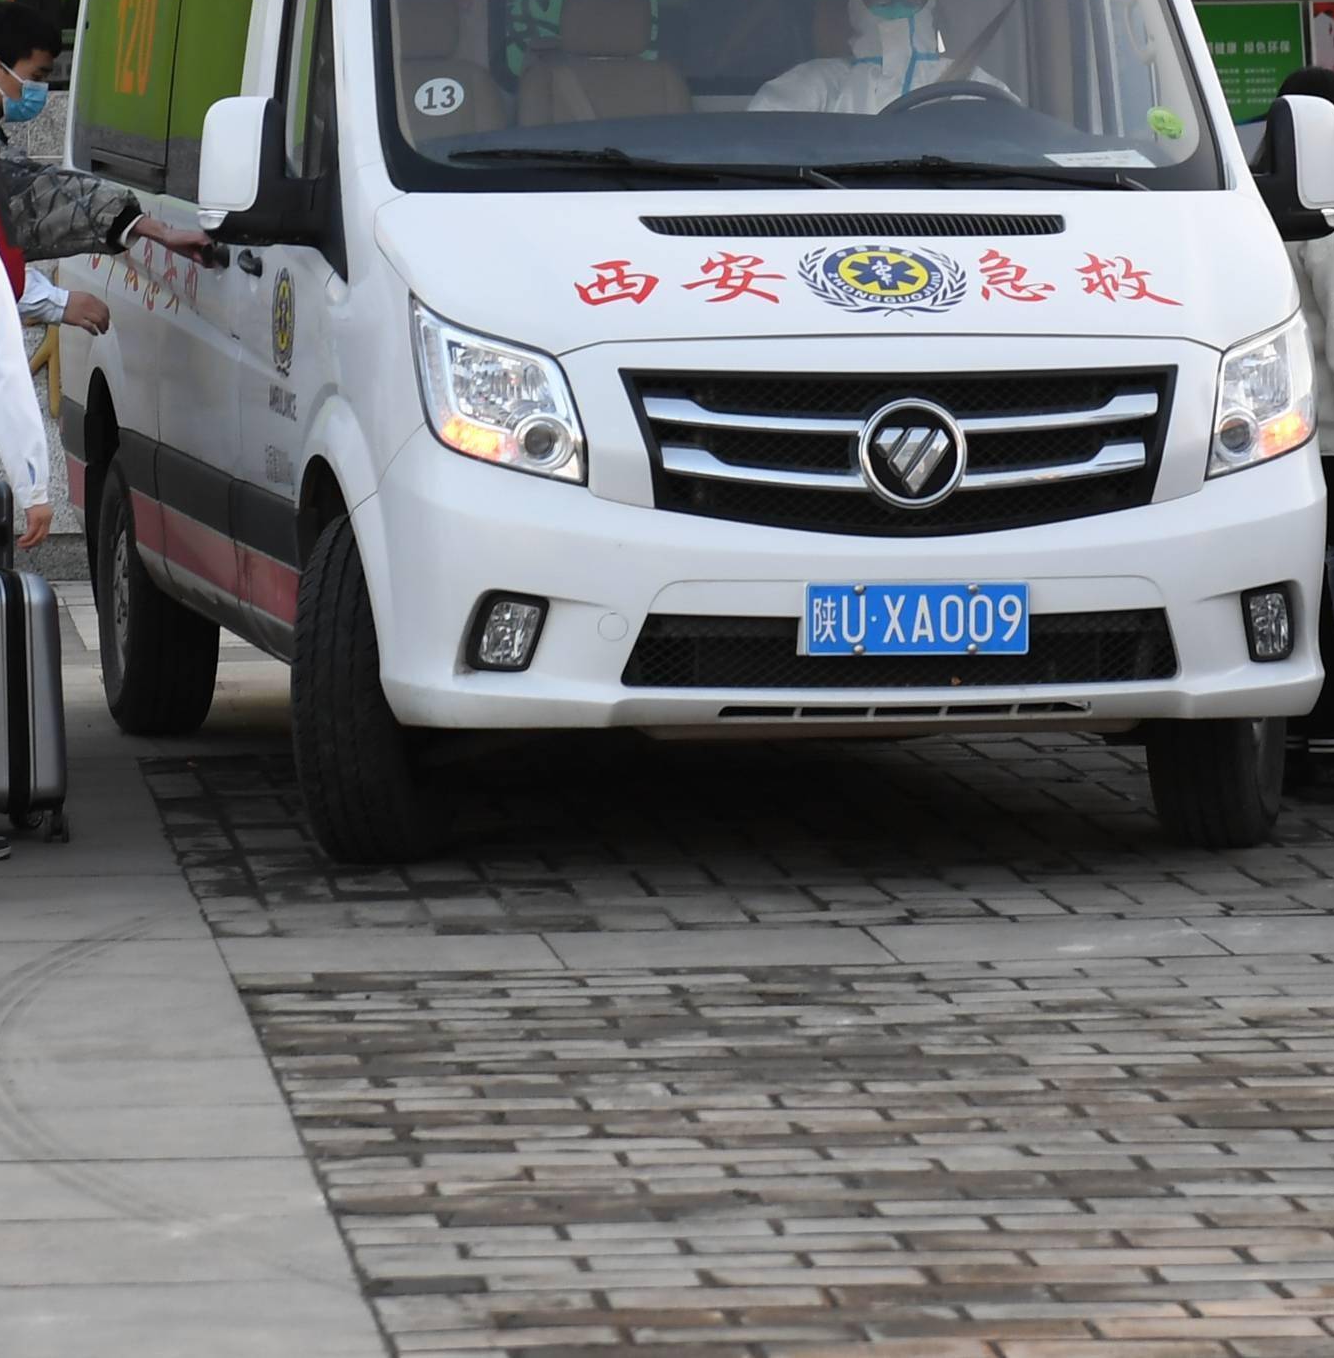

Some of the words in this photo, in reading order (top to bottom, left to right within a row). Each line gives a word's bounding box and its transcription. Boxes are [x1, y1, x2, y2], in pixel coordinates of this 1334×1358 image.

[422, 85, 456, 110] 13
[574, 251, 787, 305] 西安
[979, 248, 1184, 306] 急救
[812, 593, 1024, 644] 陕U·XA009
